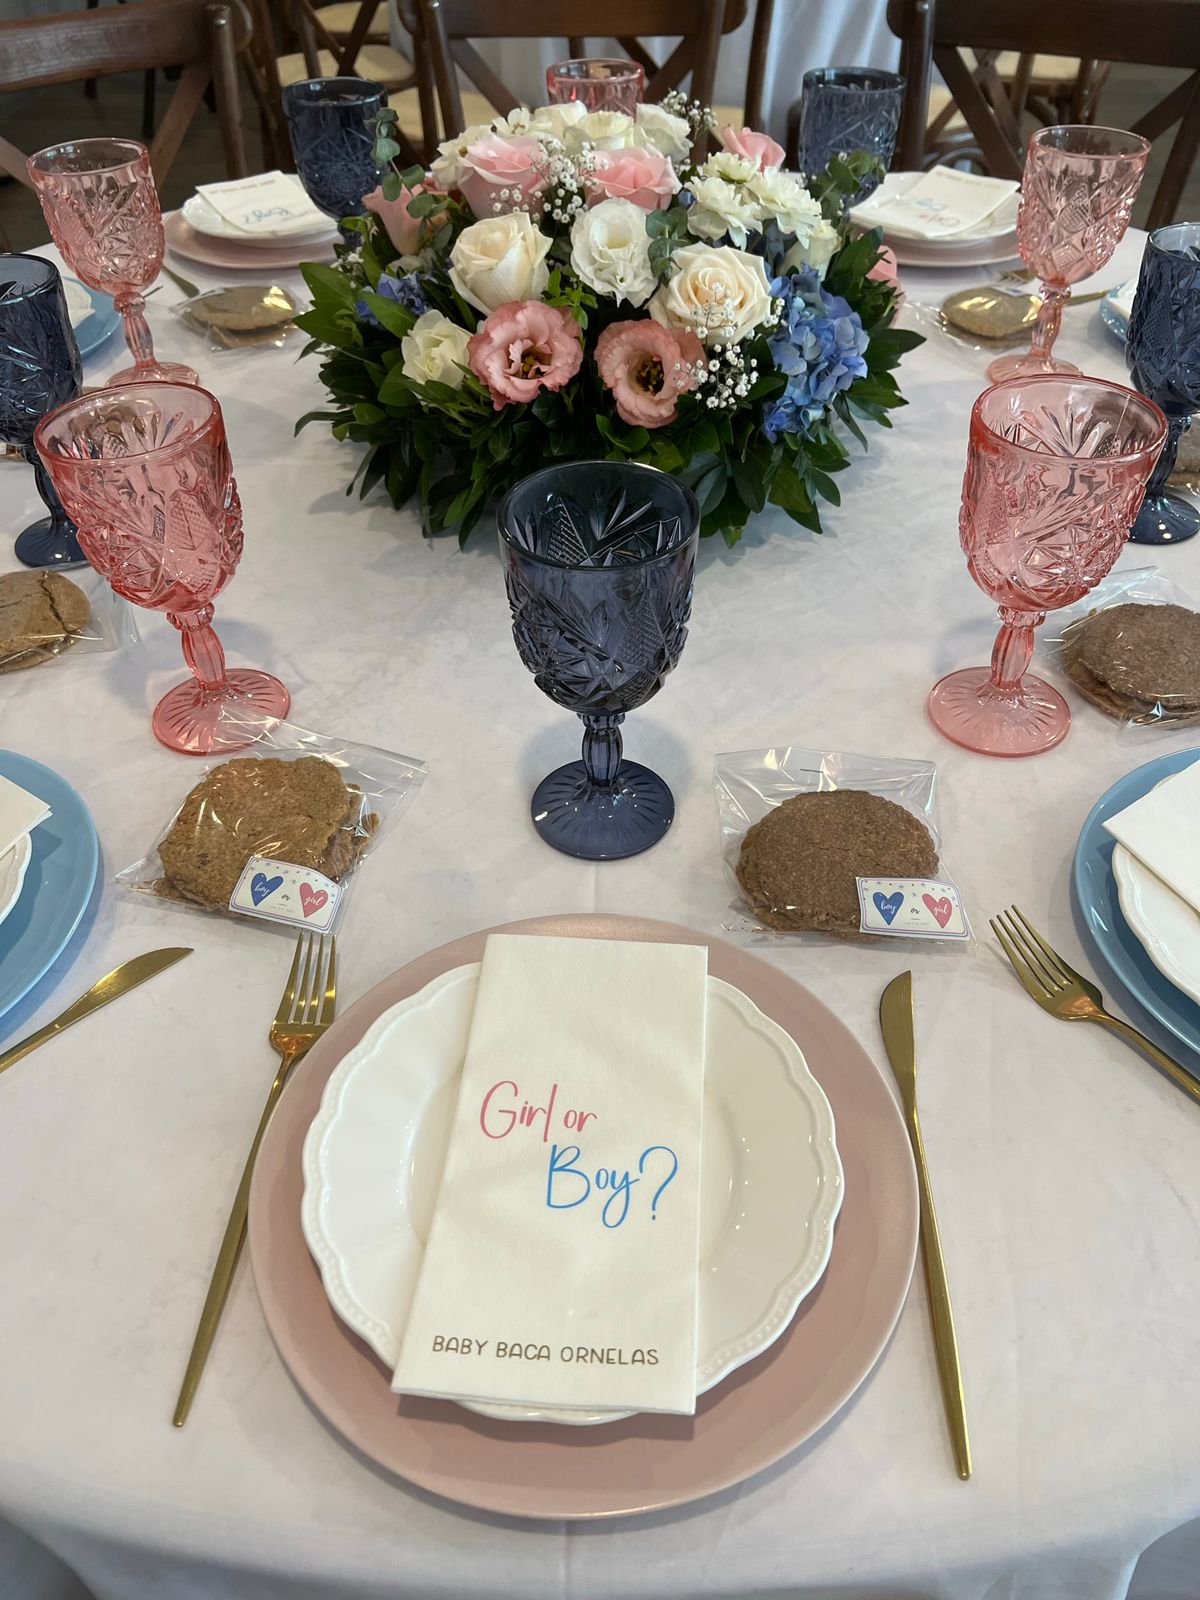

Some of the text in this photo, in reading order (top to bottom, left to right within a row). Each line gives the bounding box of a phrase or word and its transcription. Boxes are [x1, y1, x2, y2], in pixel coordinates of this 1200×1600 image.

[254, 881, 270, 897] boy
[304, 895, 323, 906] girl
[880, 900, 896, 915] boy
[933, 903, 949, 916] girl
[480, 1080, 598, 1142] Girl or
[546, 1144, 678, 1228] Boy?
[432, 1335, 659, 1365] BABY BACA ORNELAS
